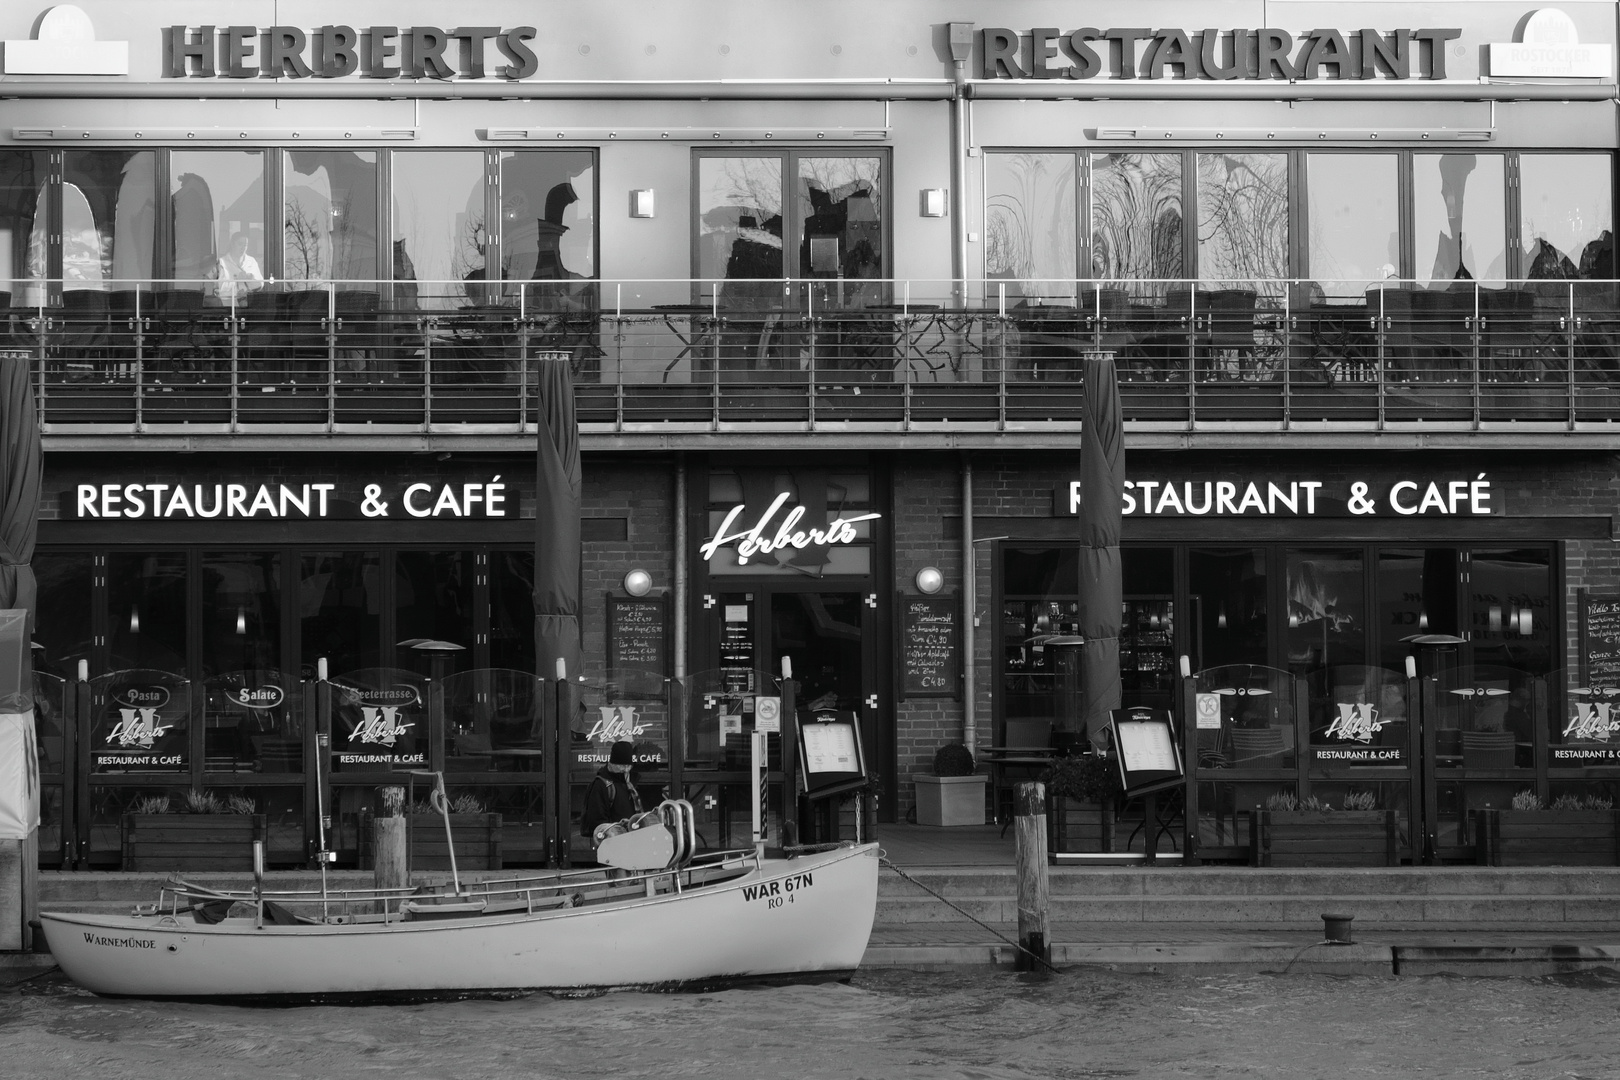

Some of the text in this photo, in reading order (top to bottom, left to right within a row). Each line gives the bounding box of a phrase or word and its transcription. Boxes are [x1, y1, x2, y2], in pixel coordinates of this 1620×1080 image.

[167, 25, 538, 79] HERBERTS
[981, 26, 1462, 81] RESTAURANT
[1510, 48, 1590, 63] ROSTOCKER
[77, 474, 506, 518] RESTAURANT & CAFÉ
[1069, 471, 1492, 515] RSTAURANT & CAFÉ
[699, 491, 882, 566] Herberts
[127, 688, 160, 703] Pasta
[239, 687, 277, 703] Salate
[97, 757, 150, 765] RESTAURANT
[160, 754, 182, 765] CAFÉ
[340, 755, 392, 763] RESTAURANT
[402, 752, 424, 763] CAFÉ
[639, 752, 661, 763] CAFÉ
[1317, 751, 1368, 759] RESTAURANT
[1378, 749, 1400, 759] CAFÉ
[1555, 750, 1607, 758] RESTAURANT
[742, 873, 813, 902] WAR 67N
[768, 894, 794, 909] RO 4
[83, 932, 156, 949] WARNEMÜNDE
